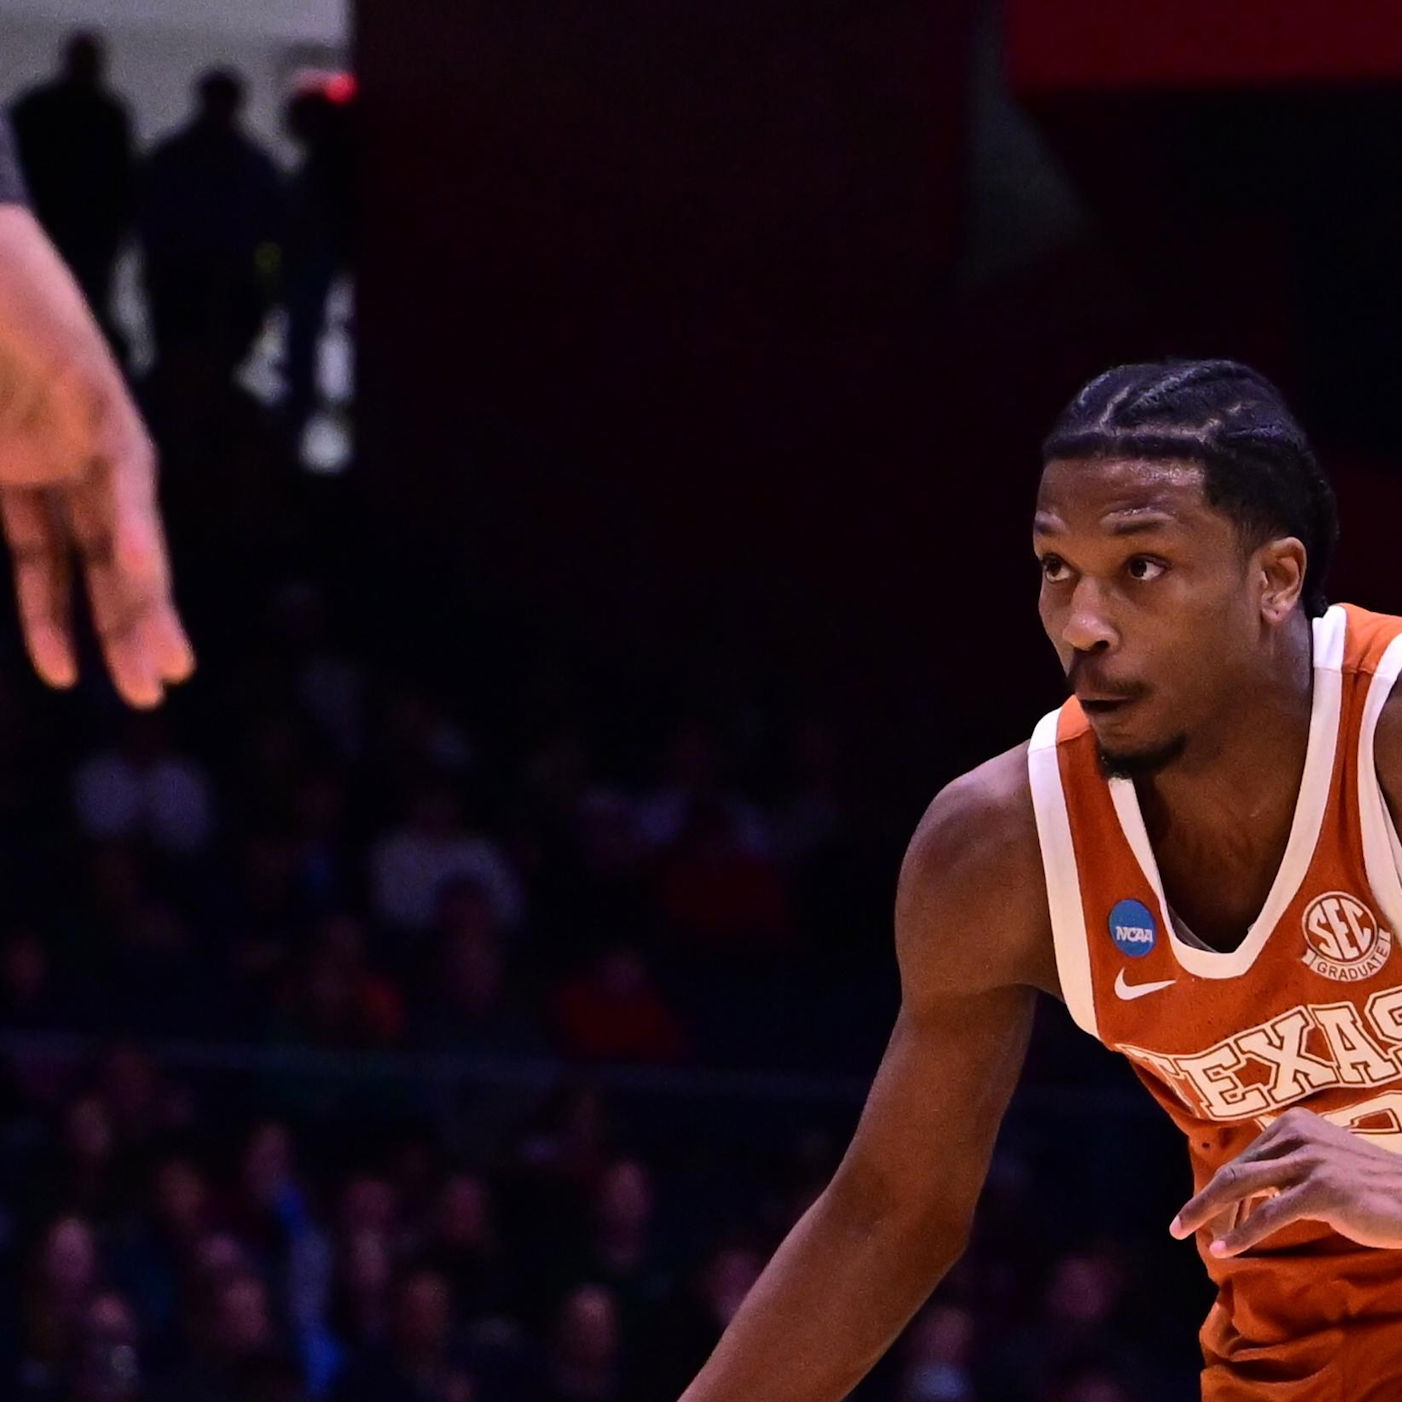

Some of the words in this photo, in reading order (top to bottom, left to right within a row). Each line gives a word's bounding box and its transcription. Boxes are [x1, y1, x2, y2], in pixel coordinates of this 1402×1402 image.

[1115, 925, 1154, 943] NCAA
[1308, 897, 1372, 960] SEC
[1316, 945, 1388, 980] GRADUATE
